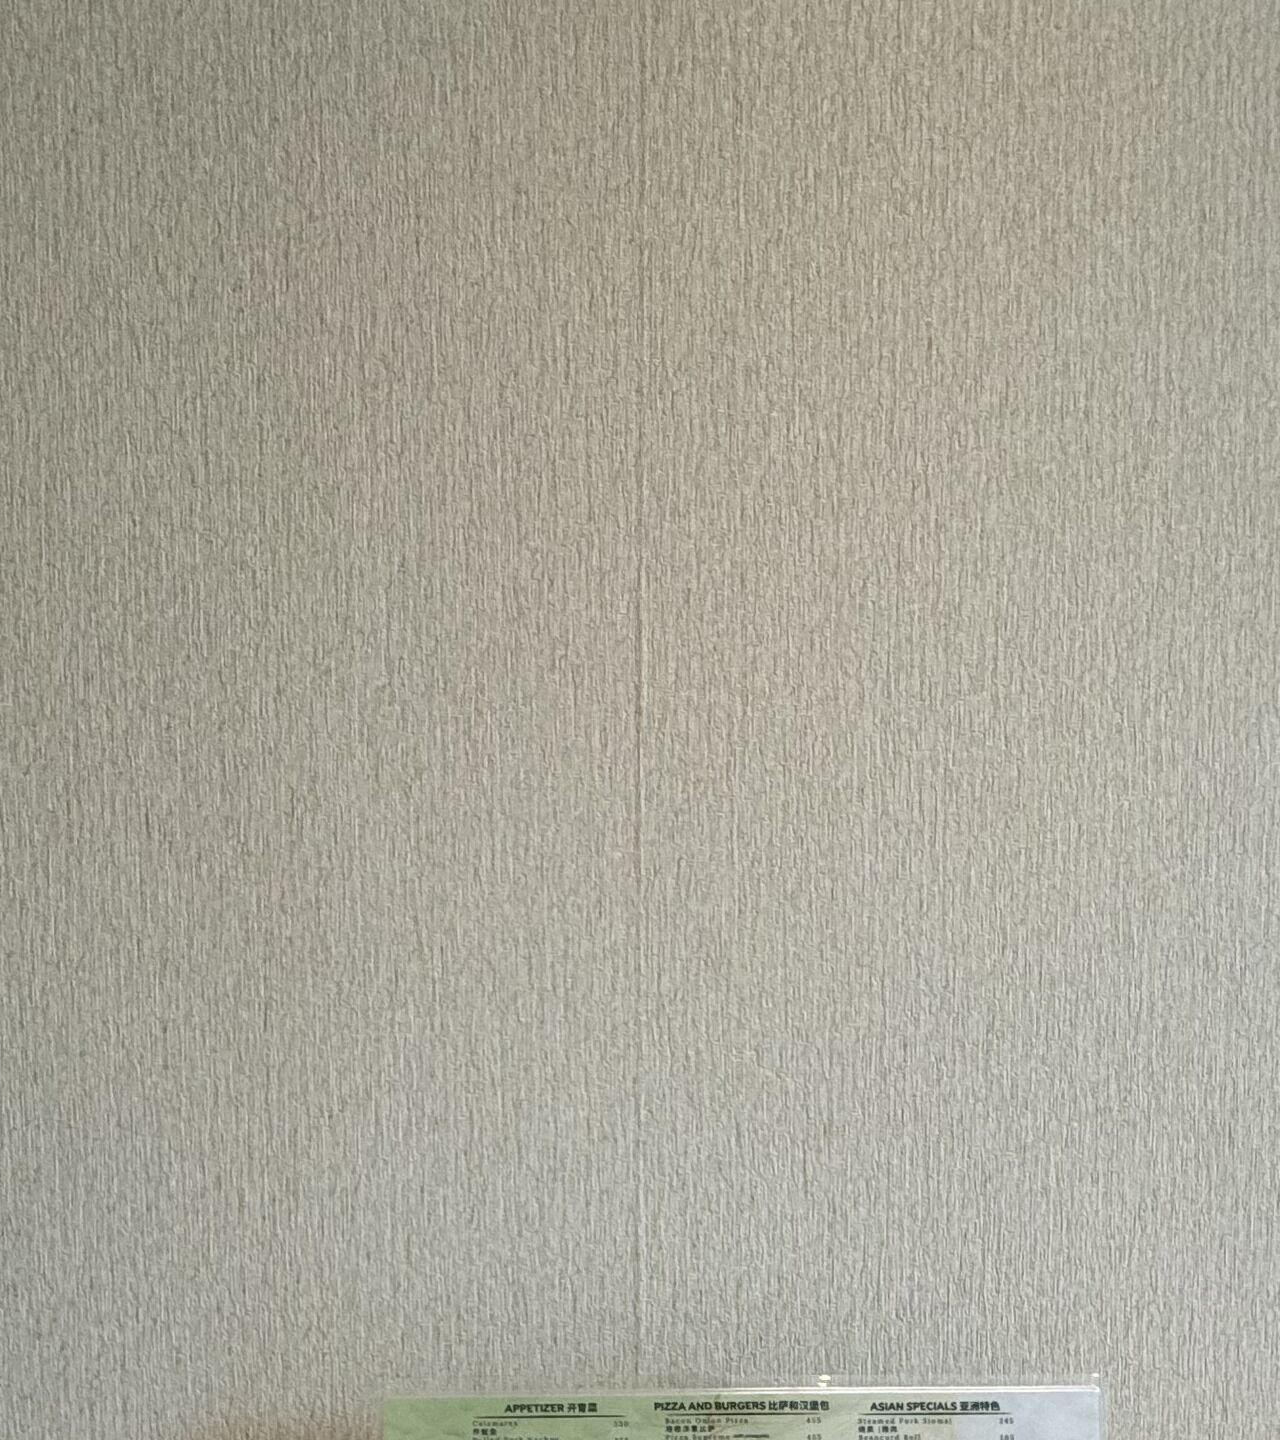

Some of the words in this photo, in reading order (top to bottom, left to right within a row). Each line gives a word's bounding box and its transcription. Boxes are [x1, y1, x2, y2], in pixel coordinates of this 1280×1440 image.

[504, 1403, 564, 1413] APPETIZER
[654, 1402, 687, 1411] PIZZA
[688, 1402, 712, 1411] AND
[714, 1402, 766, 1411] BURGERS
[870, 1402, 904, 1411] ASIAN
[906, 1402, 957, 1411] SPECIALS
